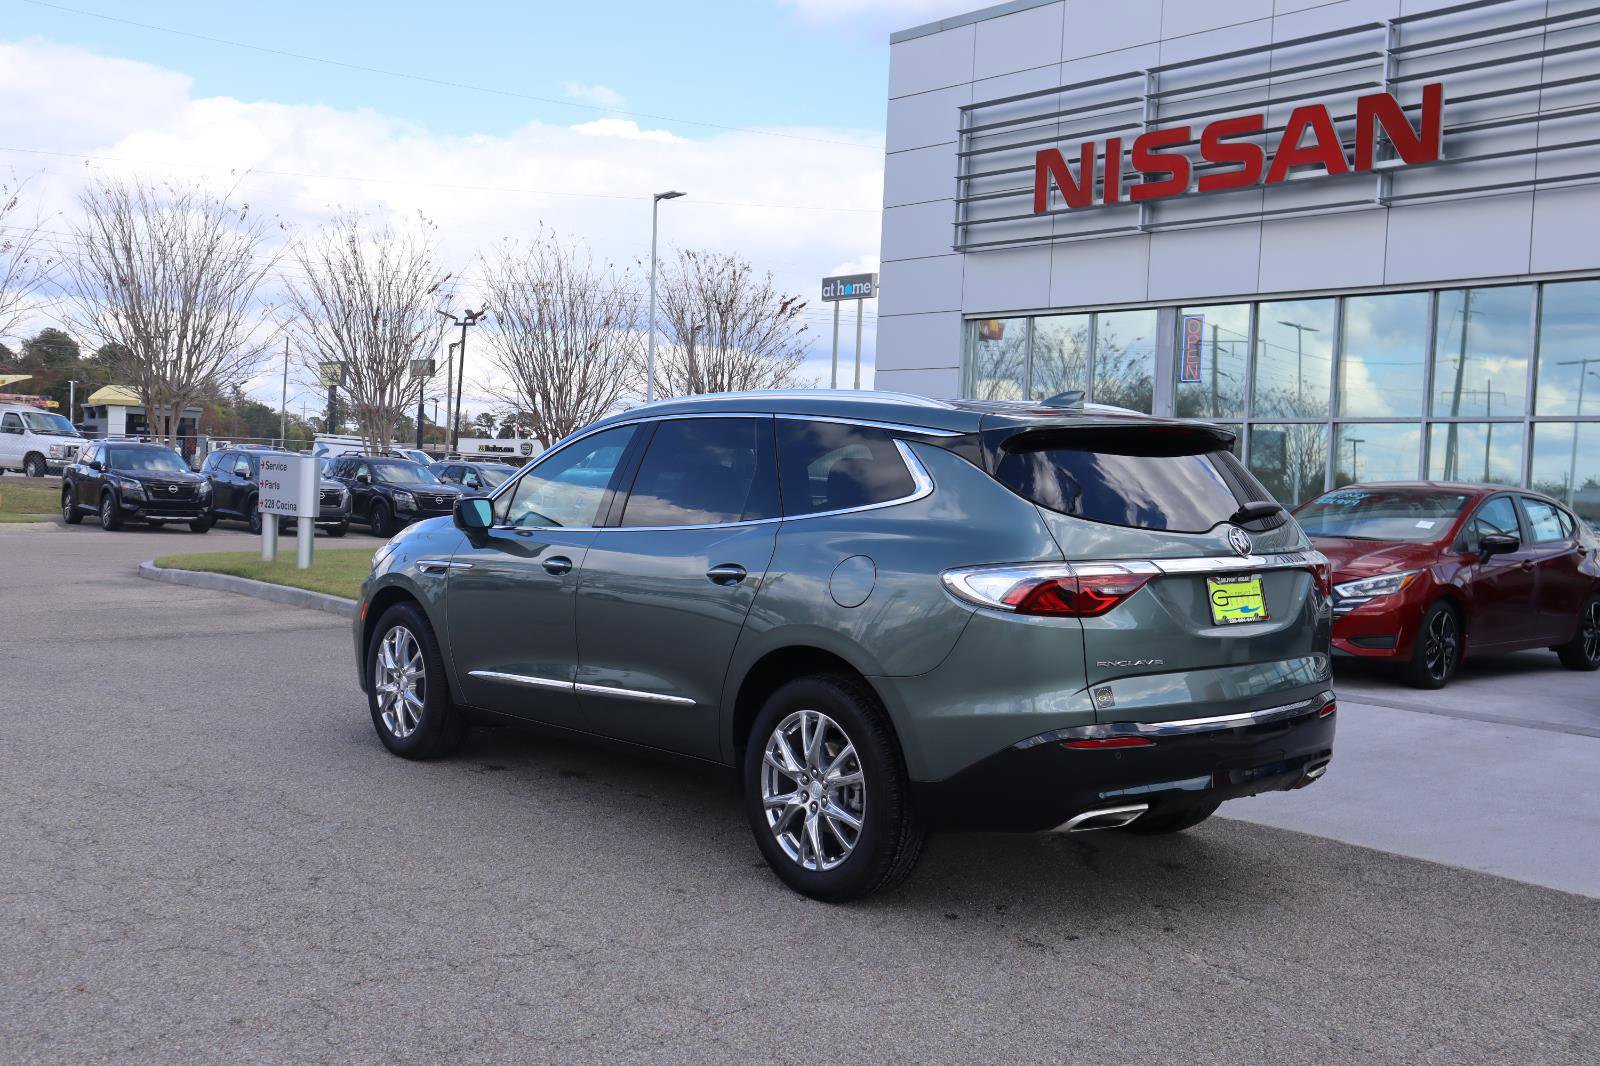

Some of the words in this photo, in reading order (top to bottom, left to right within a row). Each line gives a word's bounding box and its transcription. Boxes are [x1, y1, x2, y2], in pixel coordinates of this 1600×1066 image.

[1033, 82, 1444, 215] NISSAN
[823, 283, 834, 297] at
[837, 280, 871, 296] home
[1185, 319, 1201, 381] OPEN
[265, 461, 288, 472] Service
[264, 480, 280, 490] Parts
[264, 499, 275, 509] 228
[275, 500, 297, 512] Cocina
[1096, 659, 1164, 668] ENCLAVE
